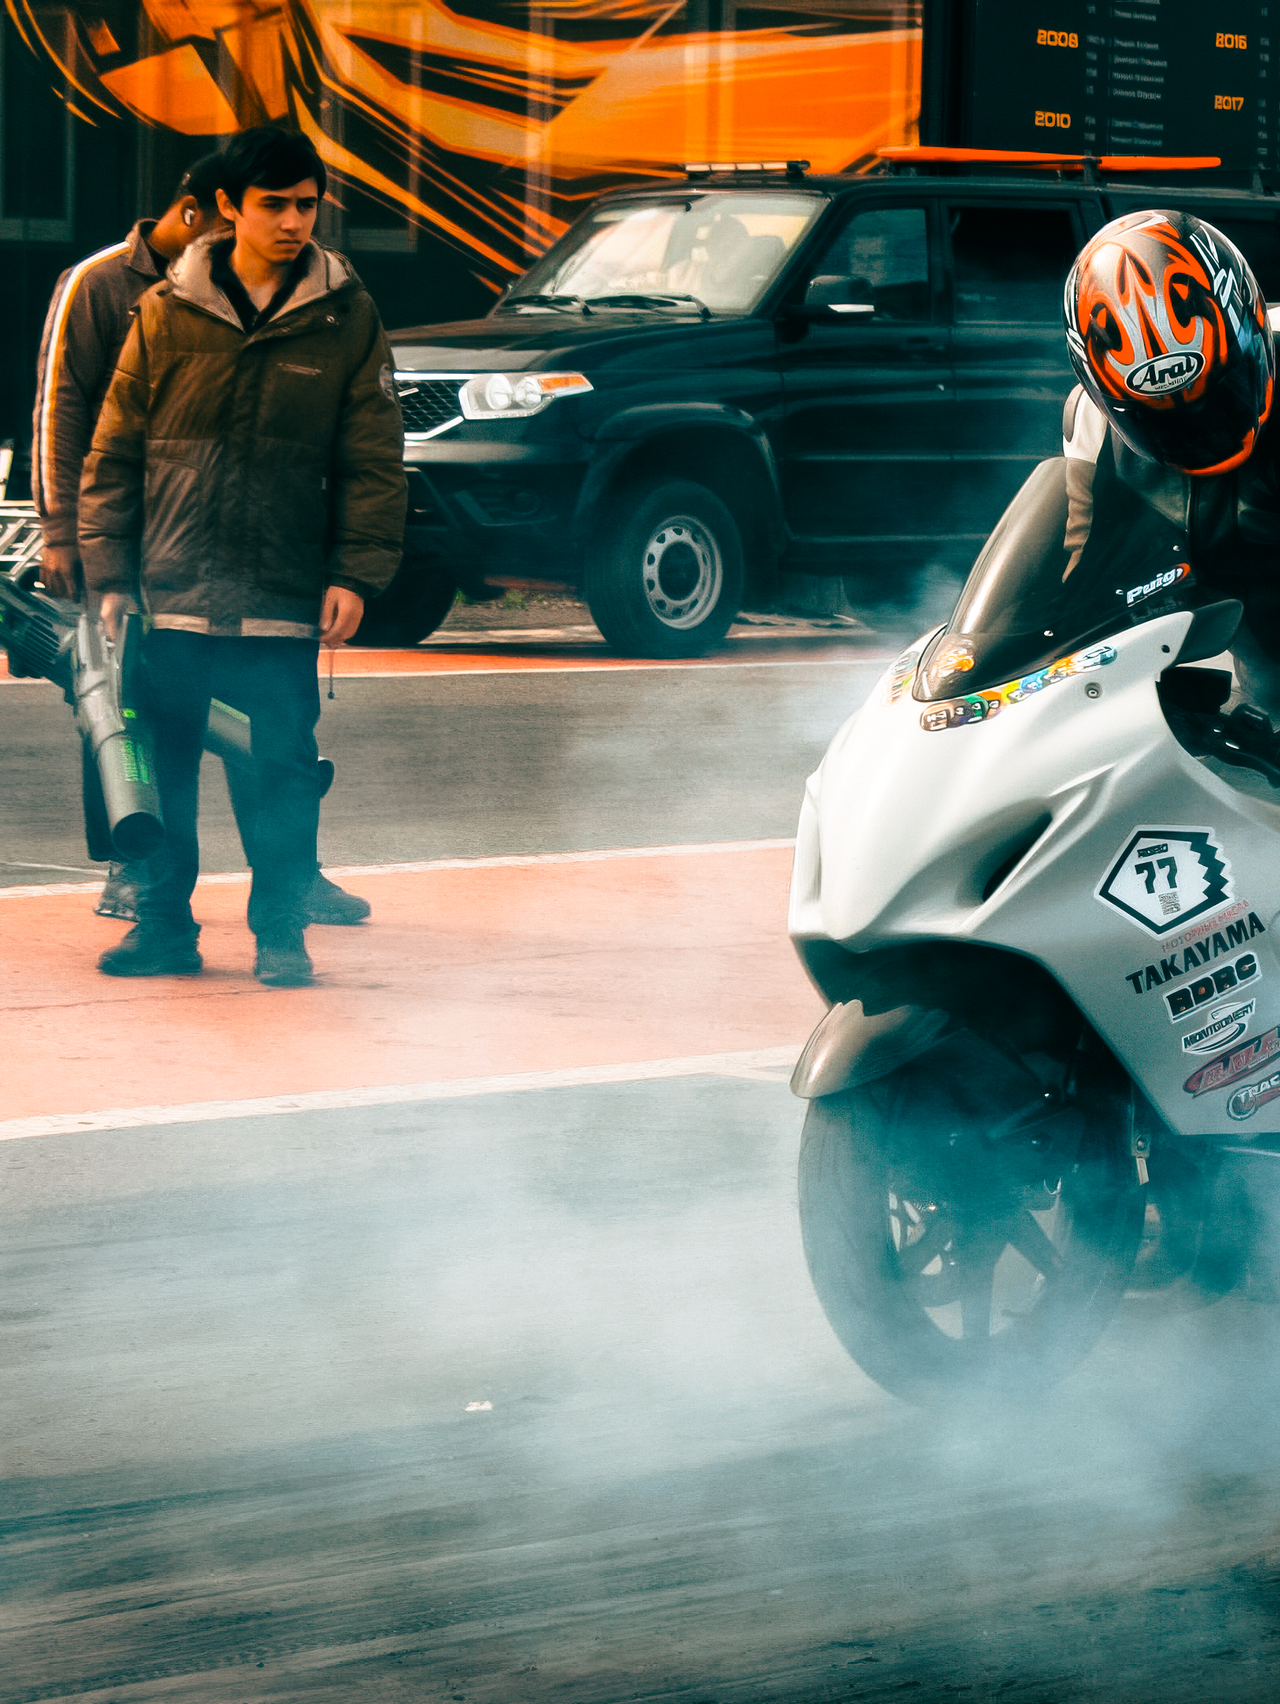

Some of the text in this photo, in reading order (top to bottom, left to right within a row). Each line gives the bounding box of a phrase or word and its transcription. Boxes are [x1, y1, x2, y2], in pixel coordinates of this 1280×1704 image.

[1215, 32, 1247, 49] 2016
[1034, 110, 1071, 128] 2010
[1214, 95, 1244, 111] 2017
[1136, 356, 1195, 388] Arai
[1126, 568, 1176, 605] Puig
[1134, 856, 1178, 895] 77
[1125, 911, 1266, 995] TAKAYAMA
[1165, 953, 1258, 1018] RDRC
